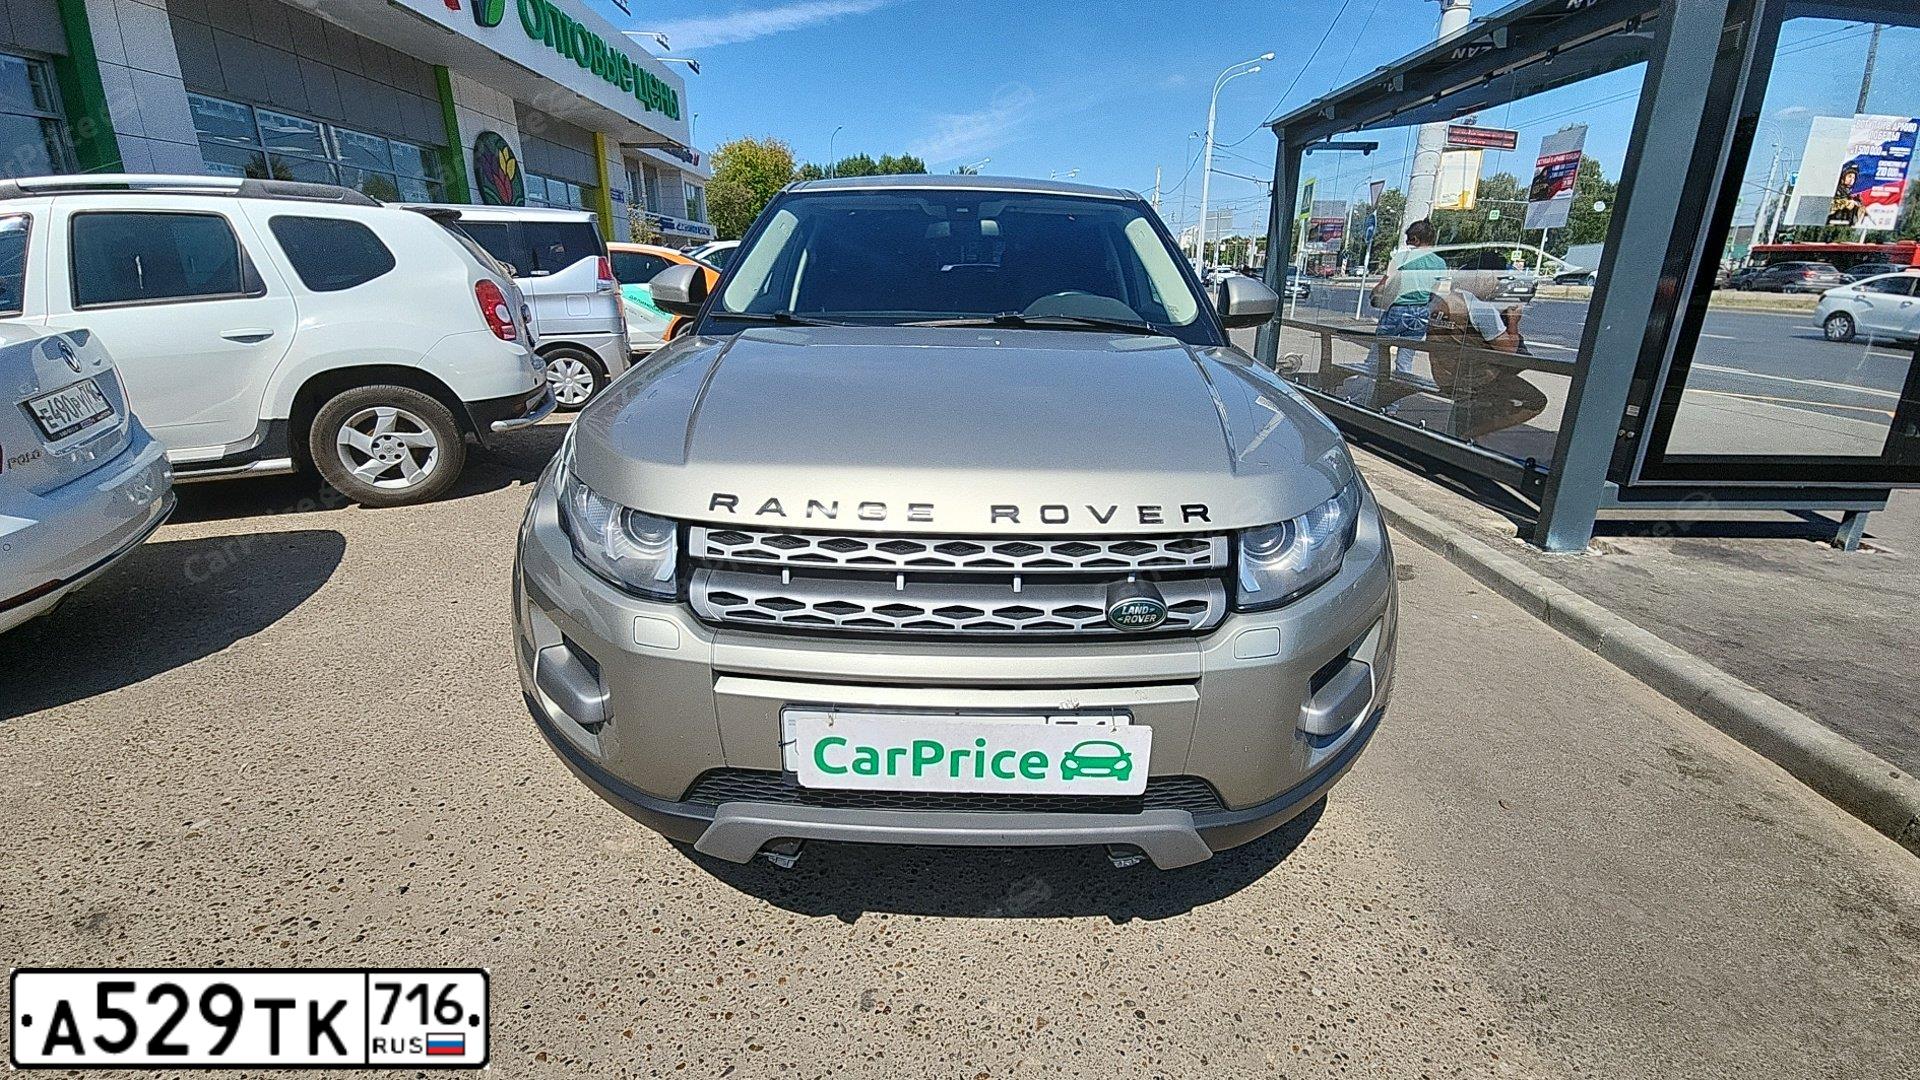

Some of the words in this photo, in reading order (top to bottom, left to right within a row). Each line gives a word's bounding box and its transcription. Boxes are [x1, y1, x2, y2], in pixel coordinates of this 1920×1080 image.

[709, 492, 935, 523] RANGE
[991, 503, 1211, 525] ROVER
[1121, 606, 1149, 614] LAND
[1123, 614, 1157, 623] ROVER
[813, 736, 1049, 780] CarPrice
